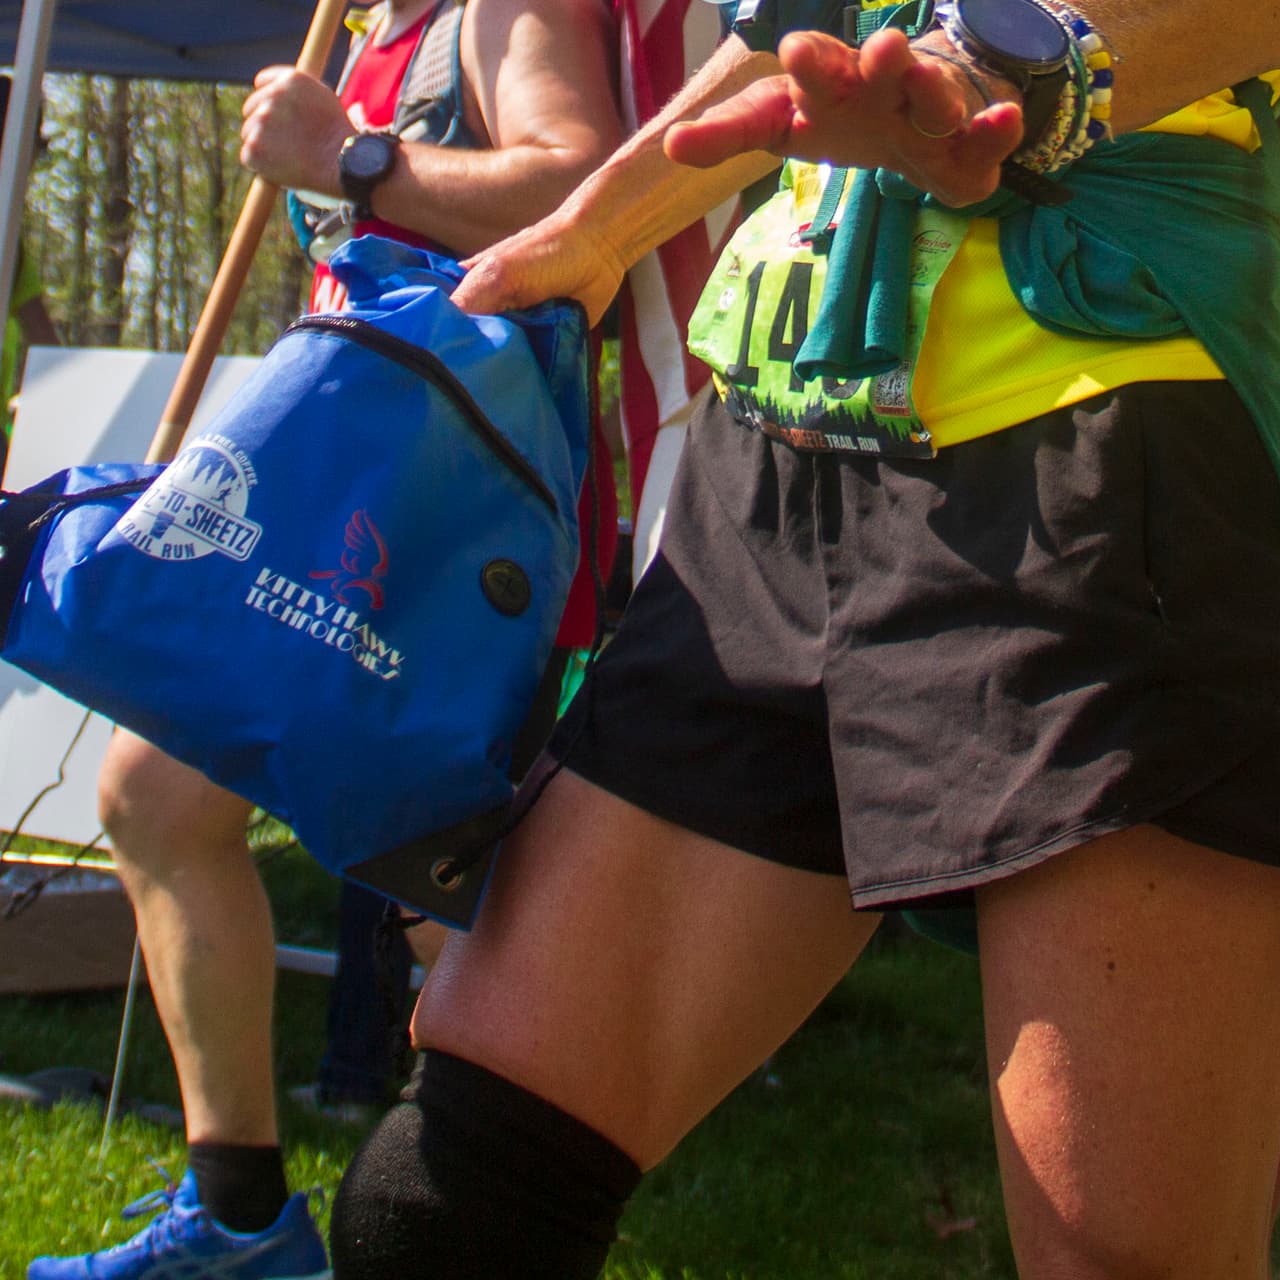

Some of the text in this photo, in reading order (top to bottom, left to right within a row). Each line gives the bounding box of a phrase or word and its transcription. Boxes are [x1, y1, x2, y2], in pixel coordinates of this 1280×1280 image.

[726, 261, 864, 400] 14
[234, 450, 259, 490] COFFEE
[824, 433, 858, 451] TRAIL
[858, 436, 881, 453] RUN
[122, 519, 195, 559] RAIL RUN
[245, 585, 400, 680] TECHNOLOGIES
[255, 567, 406, 670] KITTY HAWK
